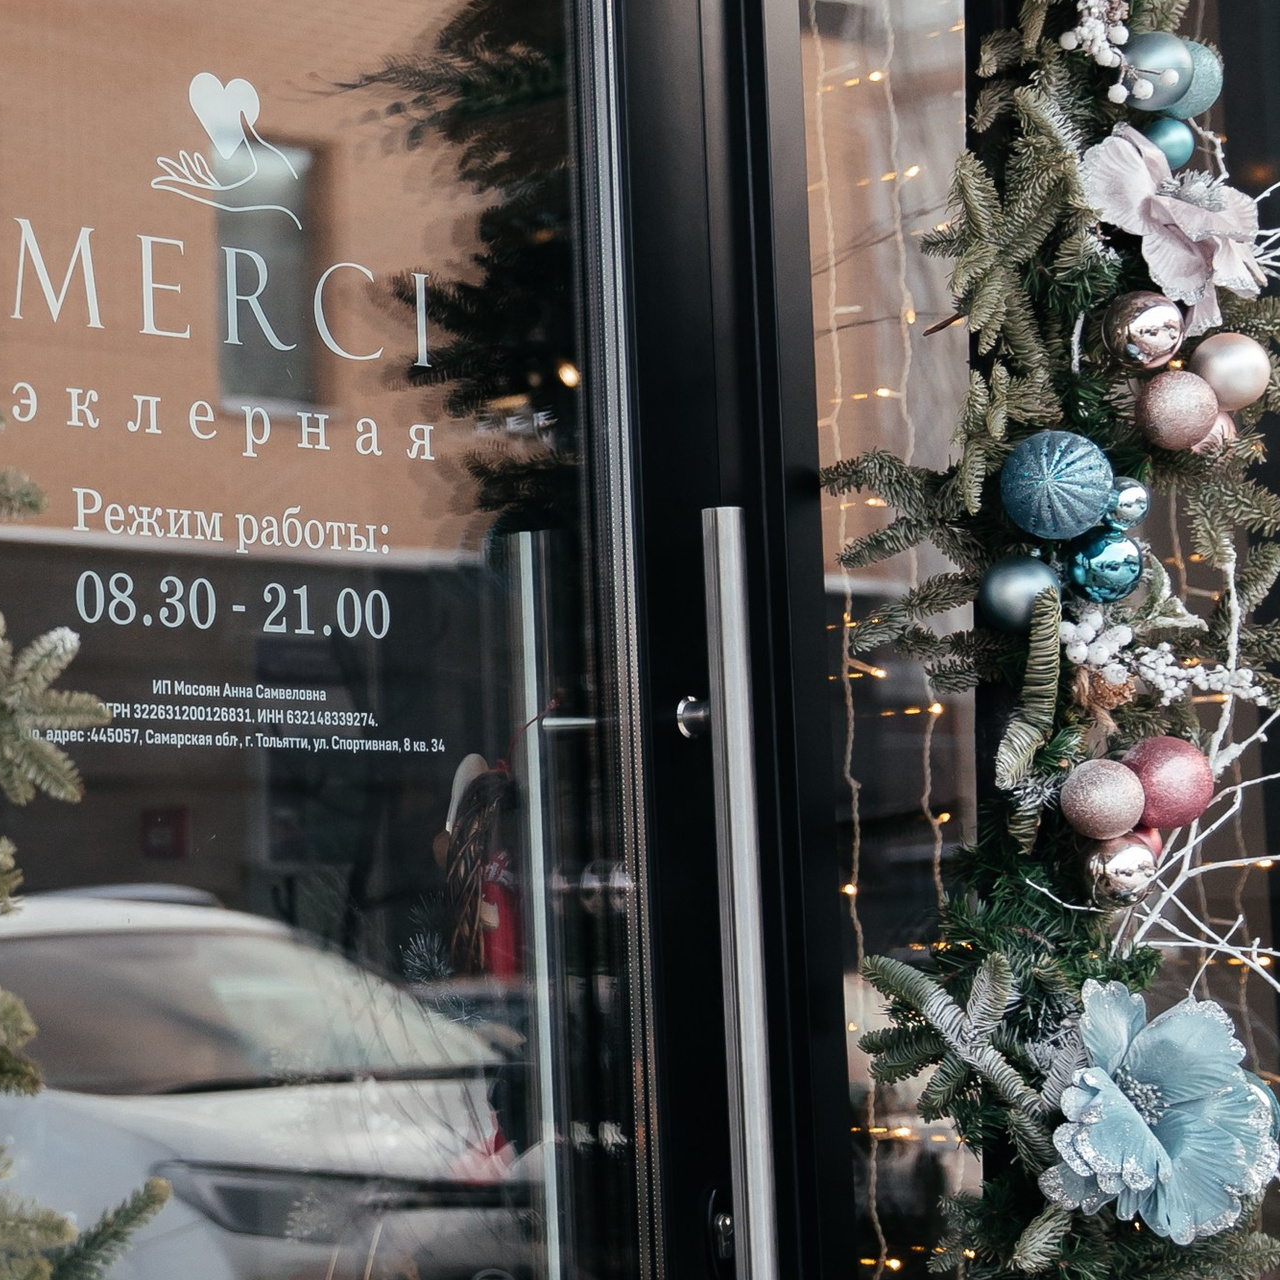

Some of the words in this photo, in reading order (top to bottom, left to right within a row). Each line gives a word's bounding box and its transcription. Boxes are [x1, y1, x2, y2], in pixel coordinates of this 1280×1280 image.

[10, 217, 432, 367] MERCI
[11, 381, 435, 461] эклерная
[72, 487, 224, 542] Режим
[235, 505, 389, 554] работы:
[75, 570, 217, 630] 08.30
[263, 582, 391, 639] 21.00
[152, 679, 172, 695] ИП
[174, 680, 220, 697] Мосоян
[223, 682, 253, 698] Анна
[255, 684, 327, 701] Самвеловна
[257, 708, 284, 724] ИНН
[286, 709, 379, 727] 632148339274.
[46, 728, 85, 745] адрес
[145, 729, 213, 749] Самарская
[245, 735, 254, 747] г.
[255, 733, 312, 751] Тольятти,
[313, 738, 330, 753] ул.
[331, 735, 402, 753] Спортивная,
[403, 737, 411, 751] 8
[413, 741, 429, 752] кв.
[431, 738, 445, 752] 34
